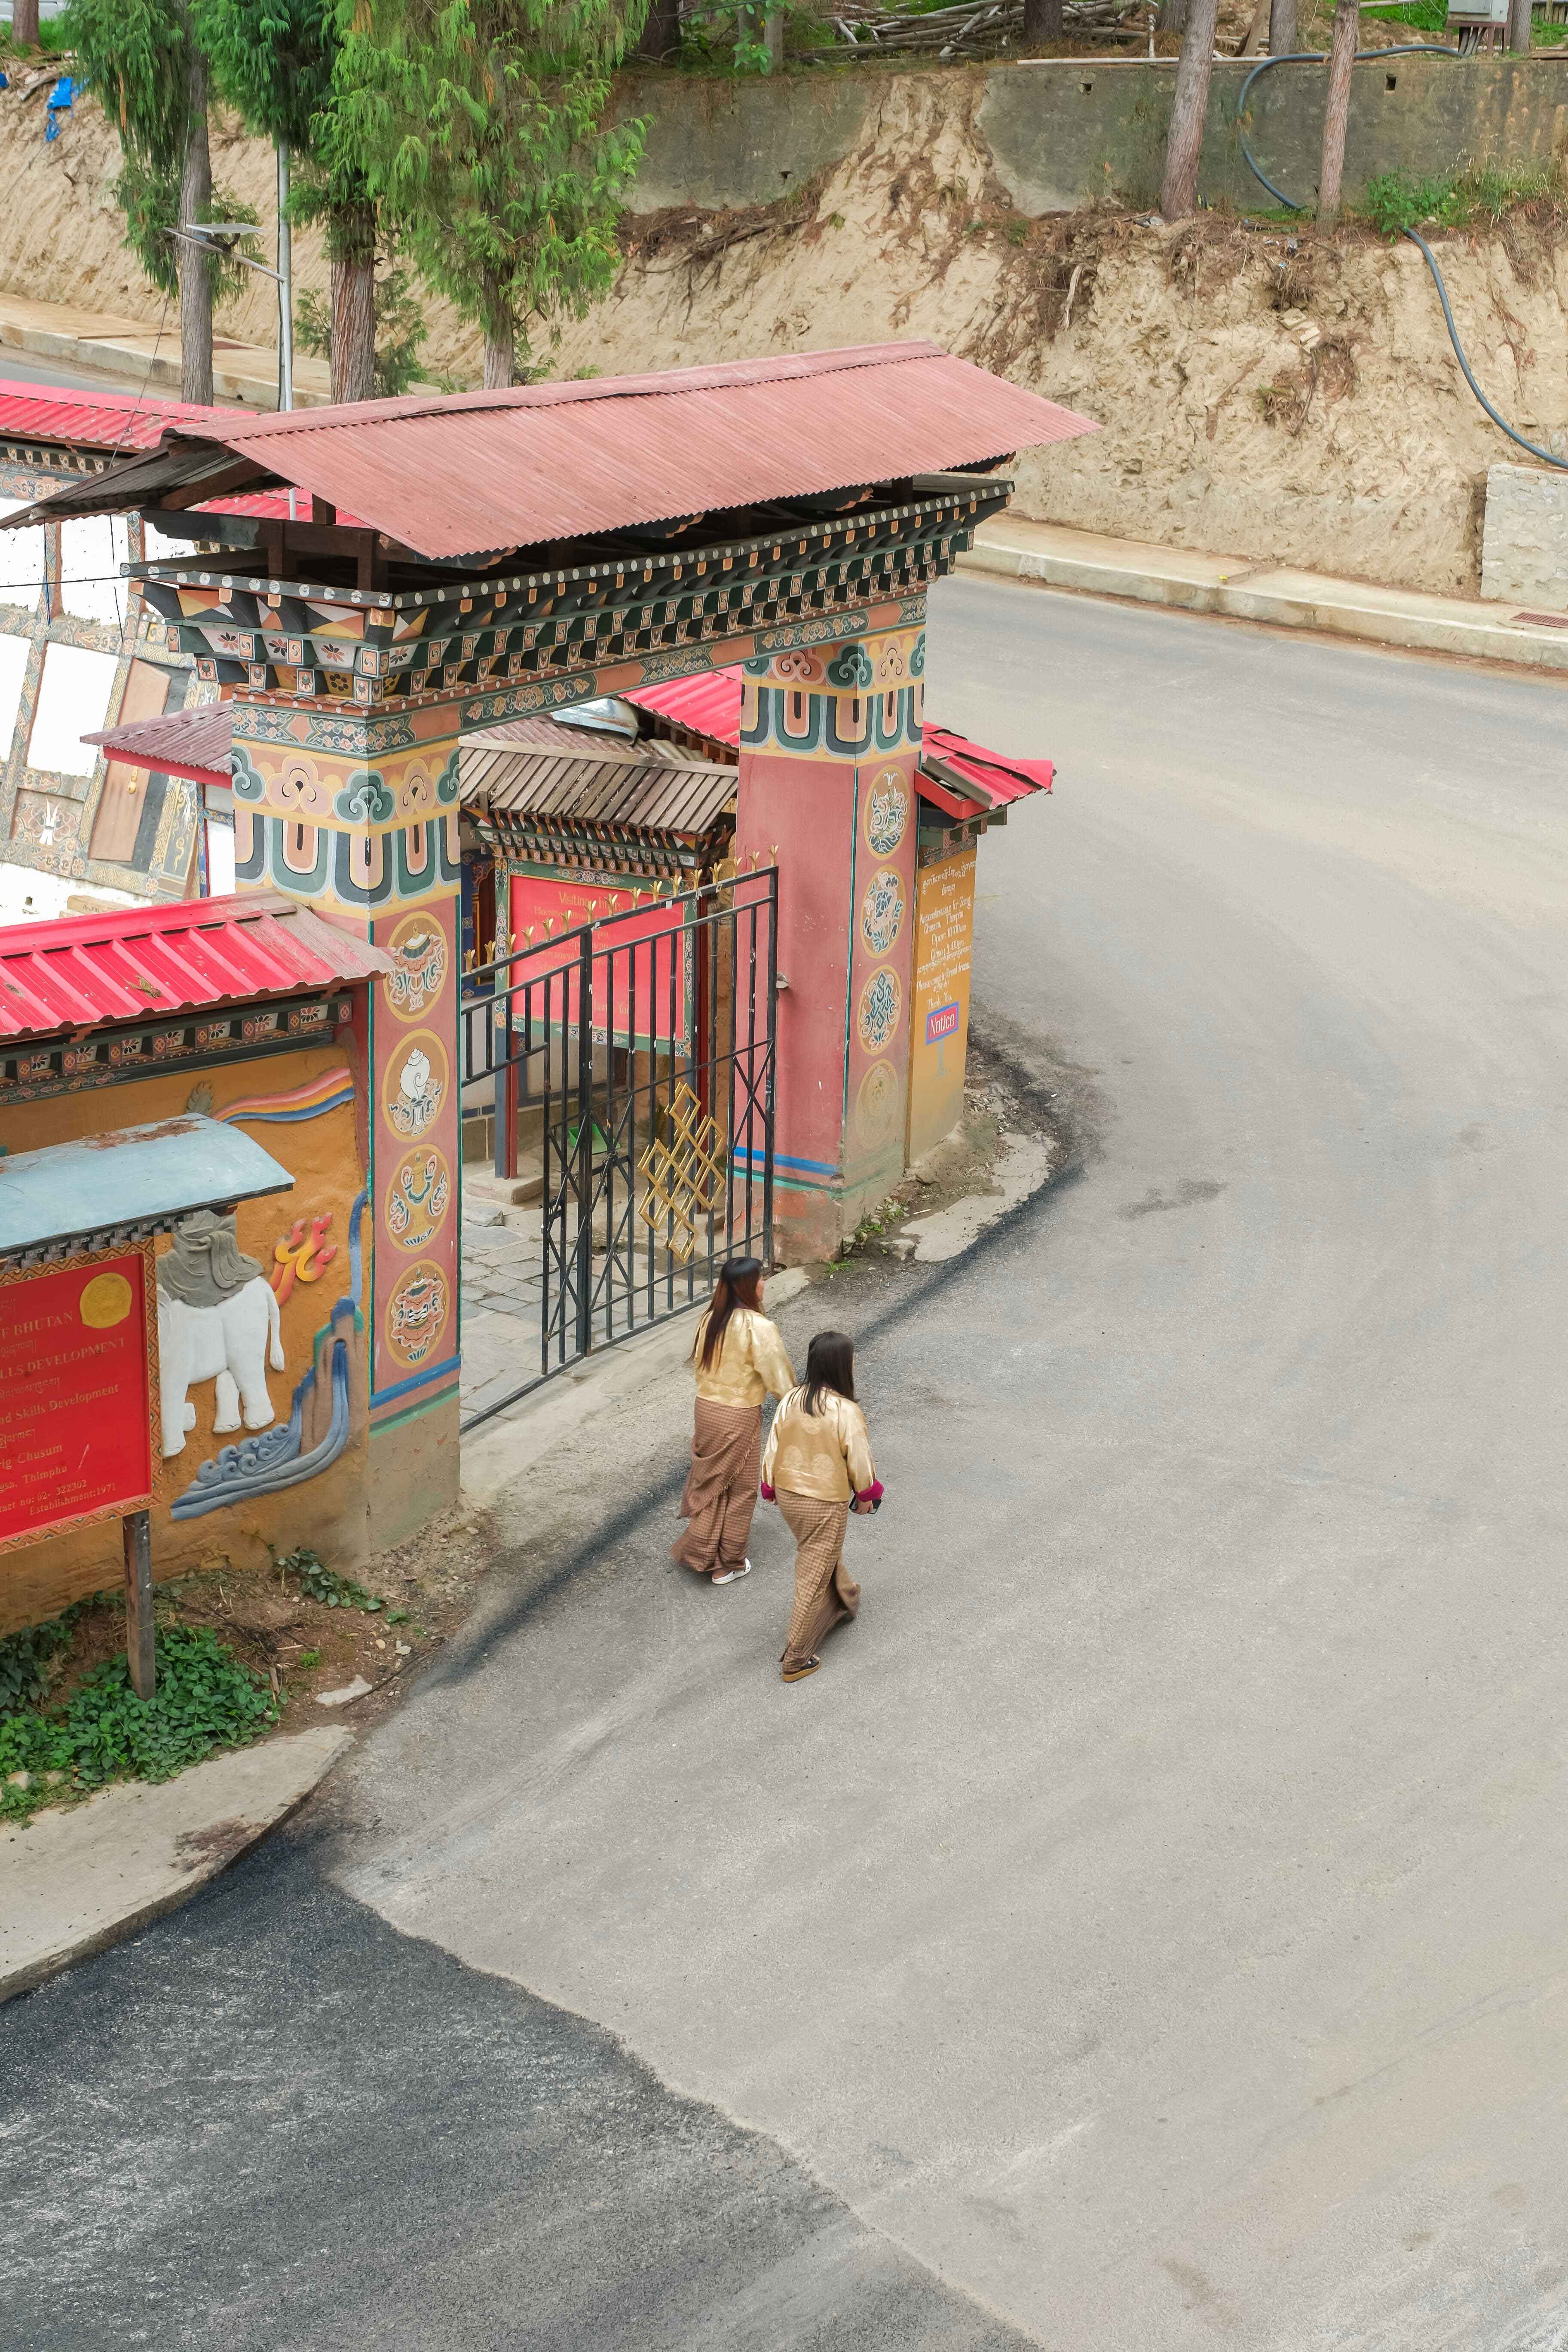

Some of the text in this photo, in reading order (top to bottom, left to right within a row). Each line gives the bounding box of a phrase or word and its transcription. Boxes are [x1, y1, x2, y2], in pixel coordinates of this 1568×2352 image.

[930, 1014, 955, 1037] Notice
[14, 1311, 74, 1336] BHUTAN
[28, 1337, 126, 1373] DEVELOPMENT
[15, 1404, 46, 1421] Skills
[48, 1384, 120, 1411] Development
[18, 1446, 63, 1464] Chusum
[22, 1464, 68, 1484] Thimphu
